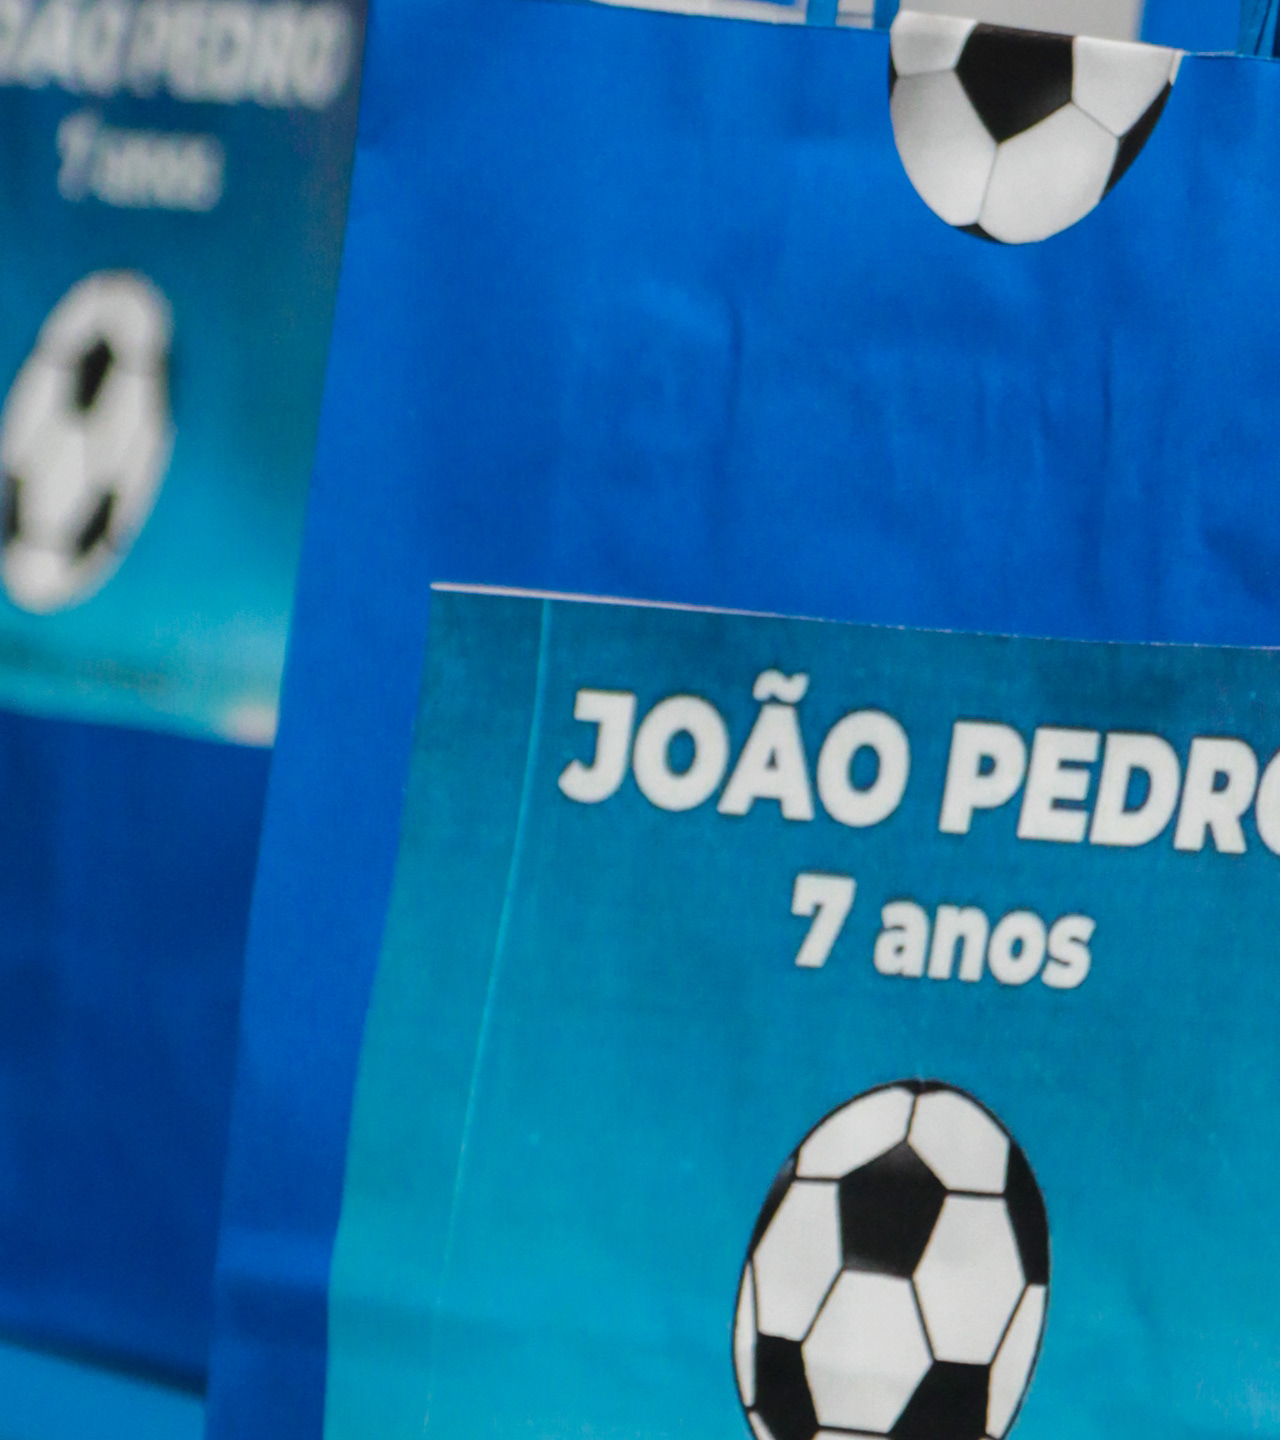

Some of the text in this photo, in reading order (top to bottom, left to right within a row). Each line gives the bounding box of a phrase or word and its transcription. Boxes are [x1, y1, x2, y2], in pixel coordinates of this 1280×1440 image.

[558, 670, 910, 828] JOÃO
[791, 873, 1096, 989] 7 anos
